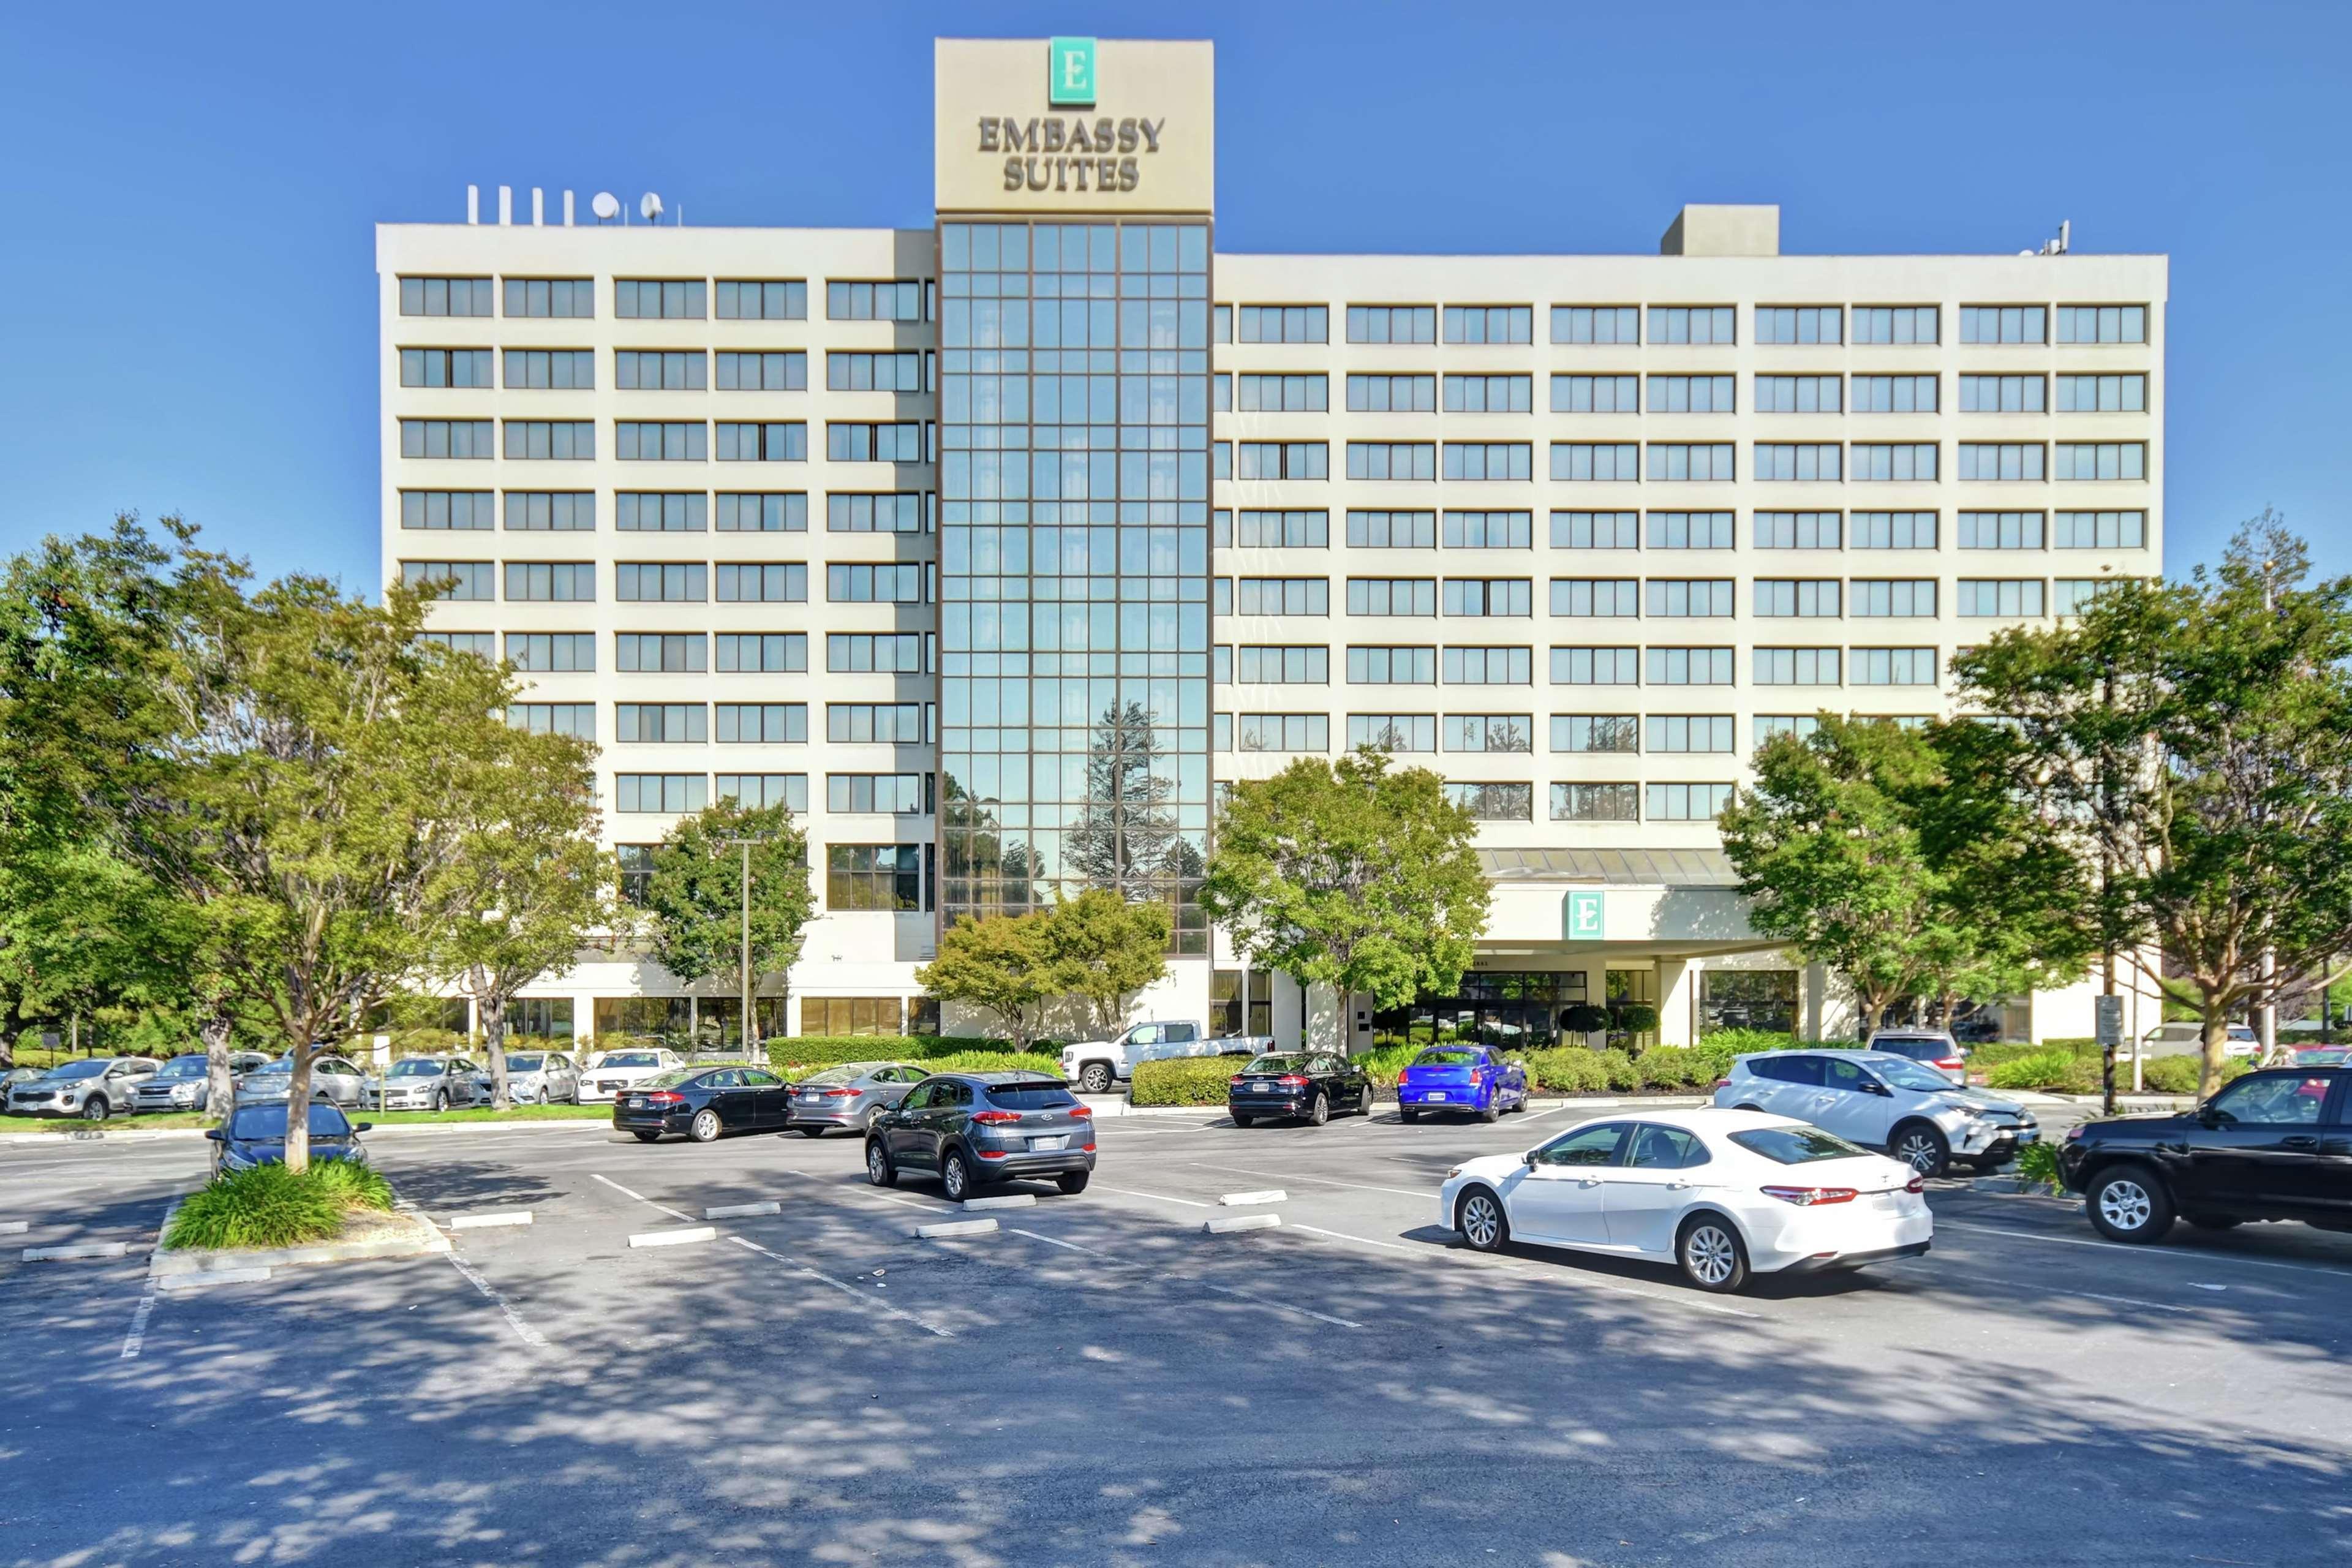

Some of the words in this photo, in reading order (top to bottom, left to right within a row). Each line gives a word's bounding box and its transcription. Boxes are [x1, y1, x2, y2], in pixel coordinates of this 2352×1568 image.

[1063, 50, 1087, 89] E
[978, 116, 1165, 153] EMBASSY
[1004, 156, 1140, 192] SUITES
[1577, 899, 1598, 930] E
